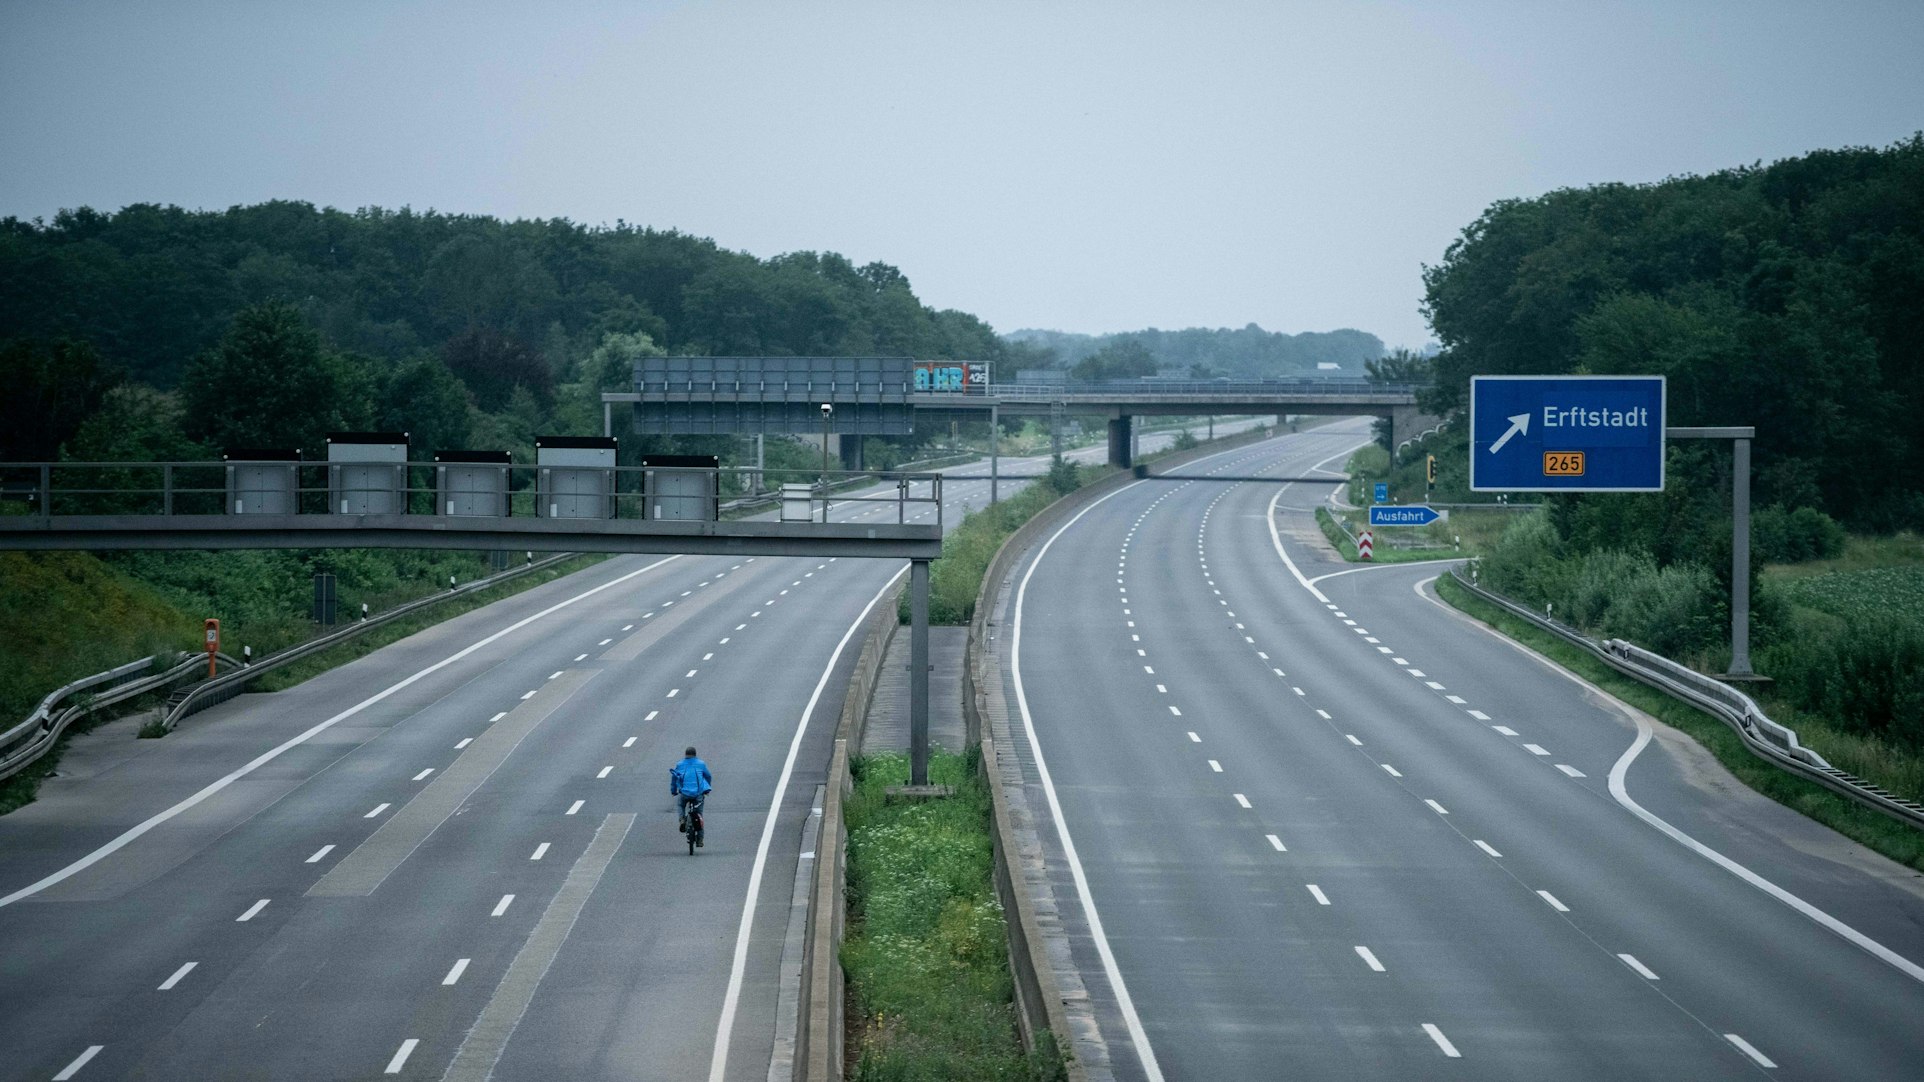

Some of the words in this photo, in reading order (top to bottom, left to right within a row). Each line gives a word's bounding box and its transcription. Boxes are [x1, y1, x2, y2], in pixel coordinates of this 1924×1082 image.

[1543, 406, 1648, 427] Erftstadt
[1549, 456, 1579, 471] 265
[1376, 511, 1424, 522] Ausfahrt
